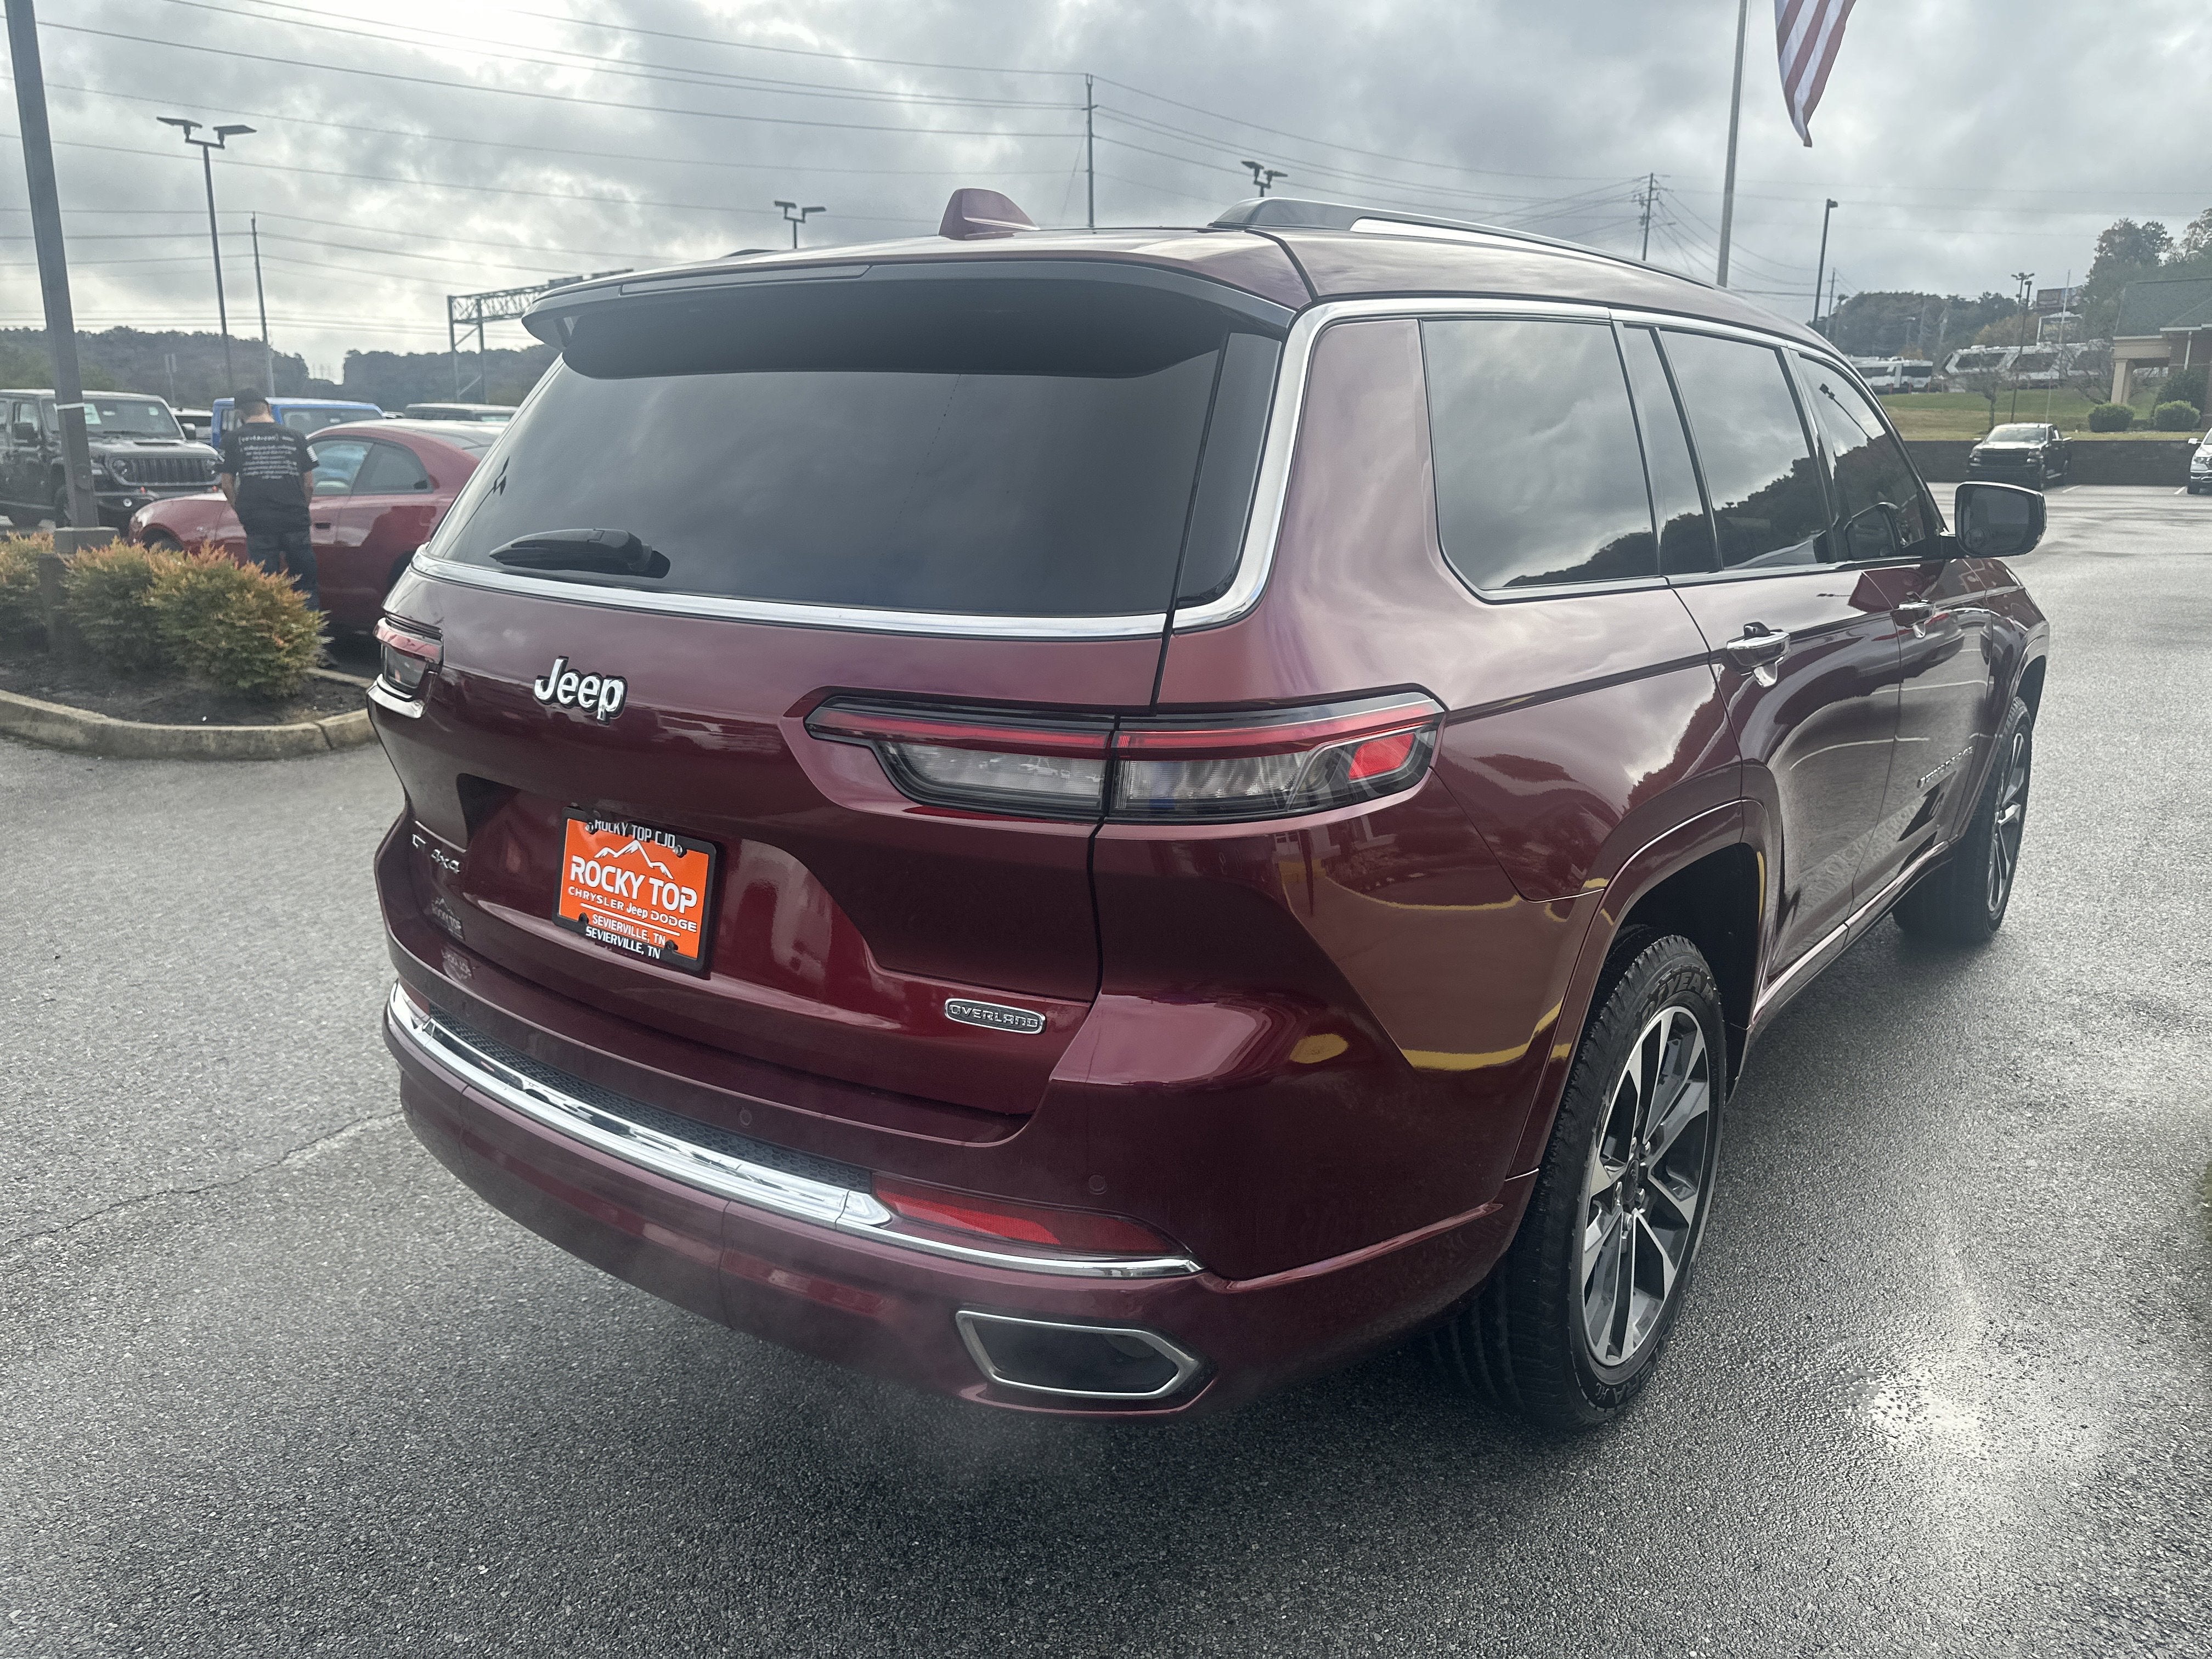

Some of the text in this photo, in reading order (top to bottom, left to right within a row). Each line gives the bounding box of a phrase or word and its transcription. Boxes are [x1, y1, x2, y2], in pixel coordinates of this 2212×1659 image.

[534, 658, 625, 721] Jeep
[631, 825, 652, 842] TOP
[654, 831, 675, 849] CJD
[570, 855, 697, 915] ROCKY TOP
[568, 886, 697, 933] CHRYSLER Jeep DODGE
[585, 926, 661, 960] SEVIERVILLE, TN
[592, 913, 666, 946] SEVIERVILLE, TN
[949, 1005, 1038, 1028] OVERLAND
